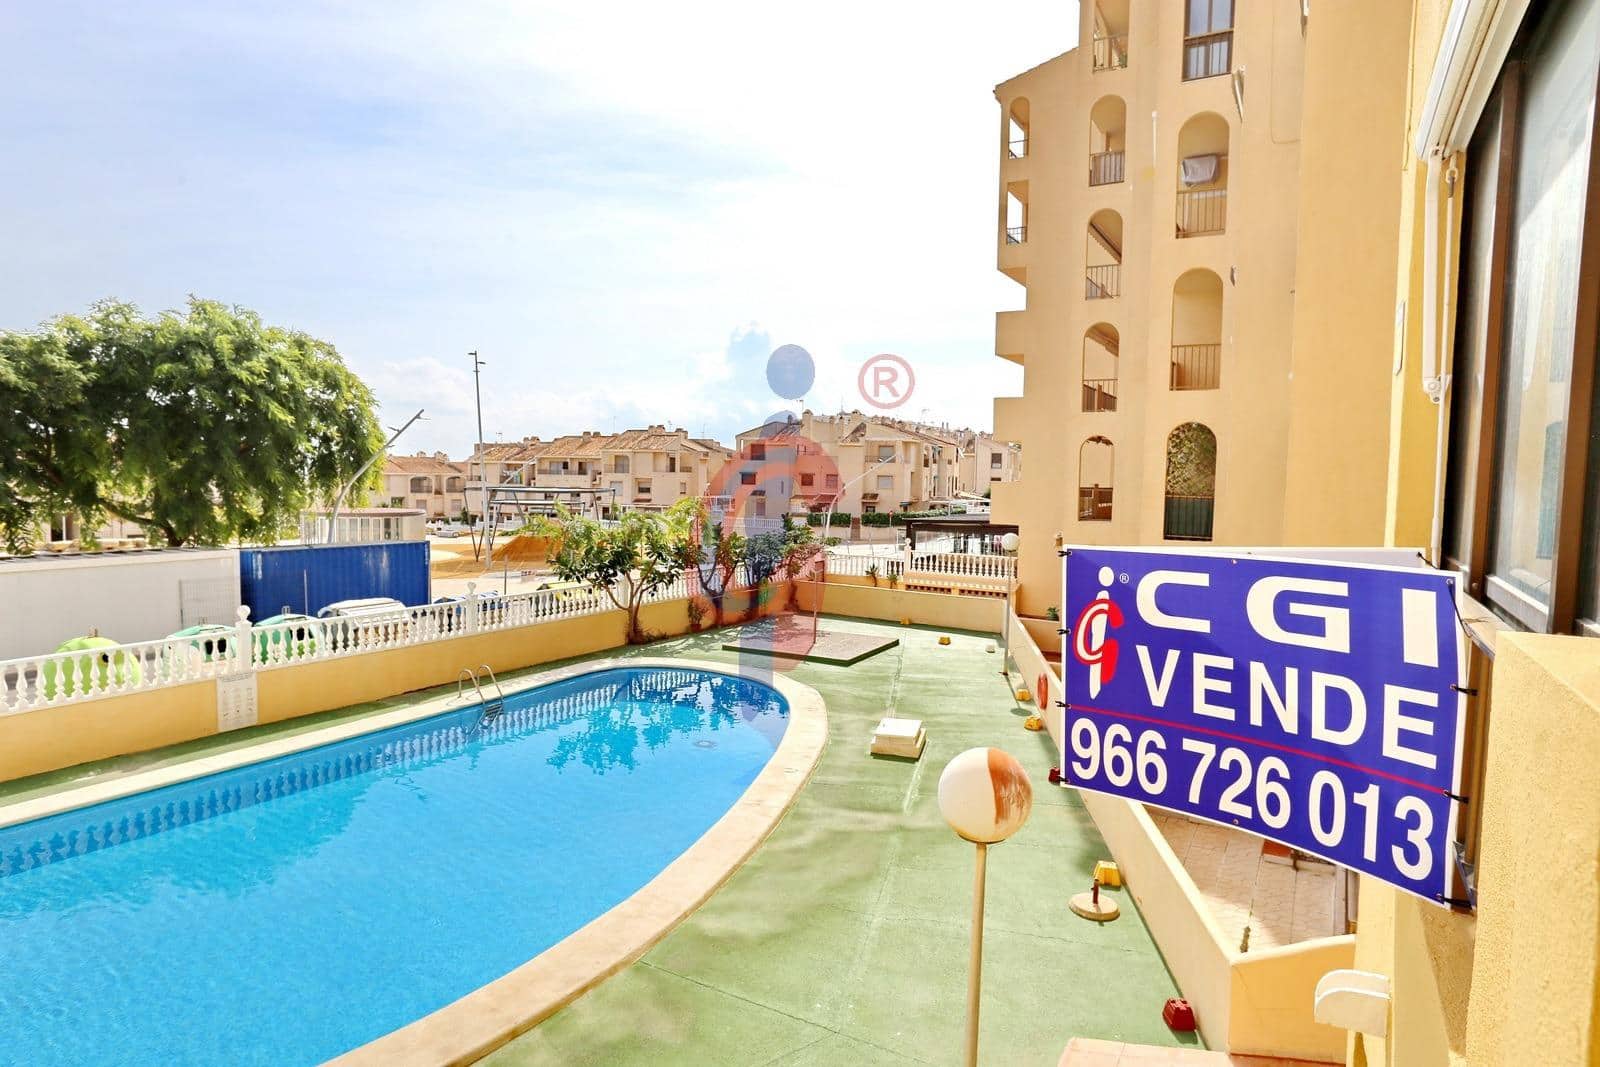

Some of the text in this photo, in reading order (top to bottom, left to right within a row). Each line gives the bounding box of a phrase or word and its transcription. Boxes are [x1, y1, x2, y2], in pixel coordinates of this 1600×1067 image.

[1136, 570, 1439, 668] CGI
[1135, 645, 1439, 769] VENDE
[1070, 718, 1433, 881] 966 726 013
